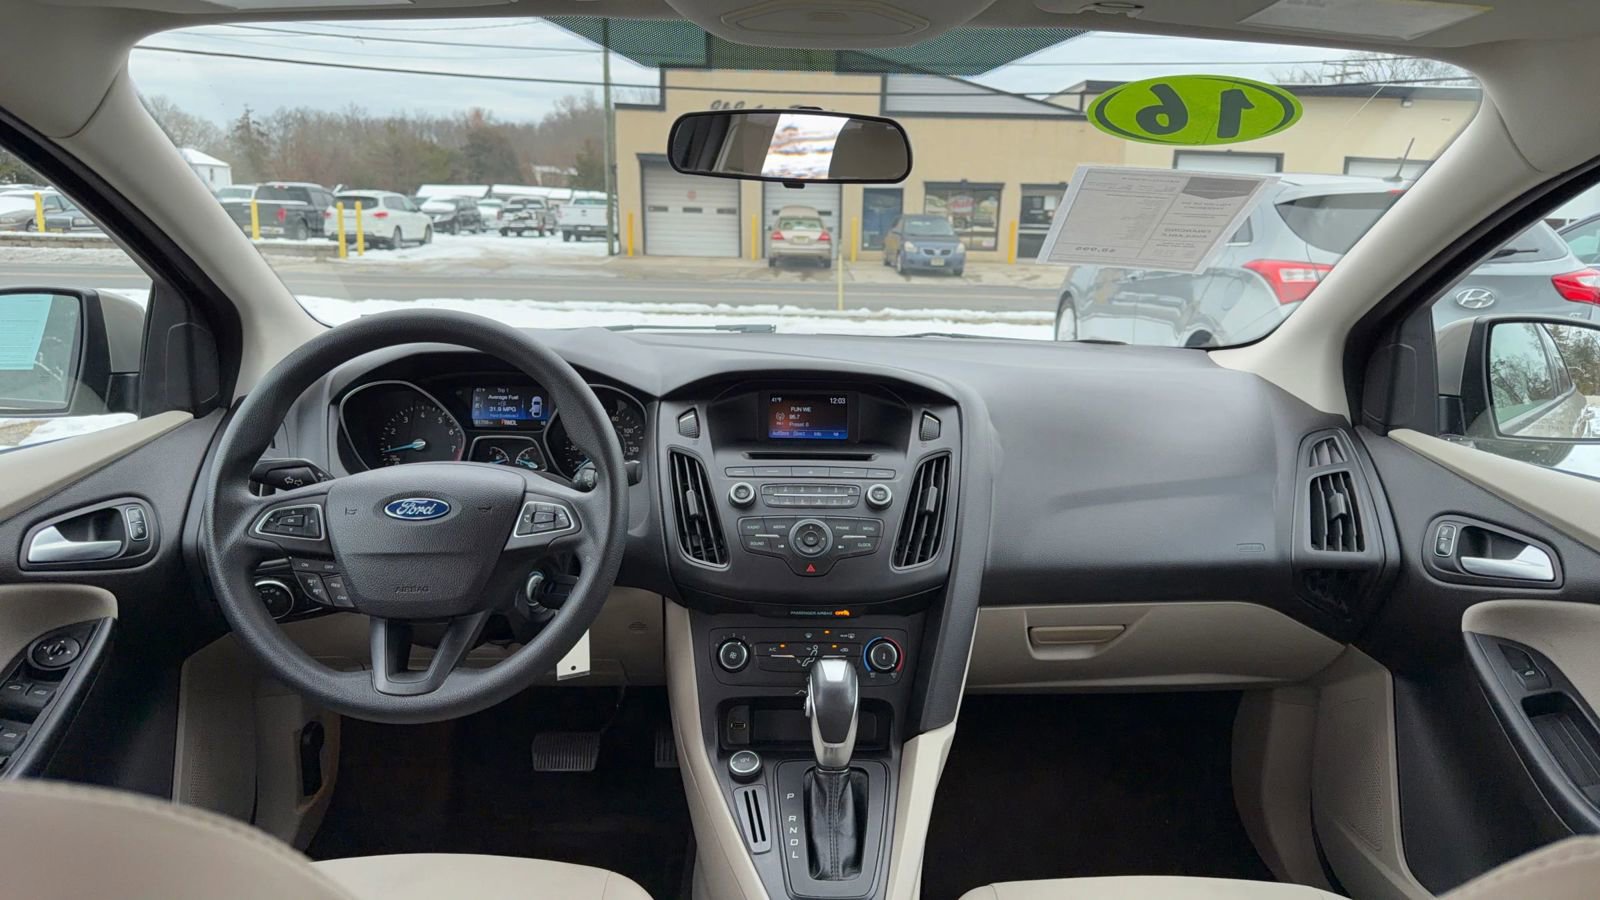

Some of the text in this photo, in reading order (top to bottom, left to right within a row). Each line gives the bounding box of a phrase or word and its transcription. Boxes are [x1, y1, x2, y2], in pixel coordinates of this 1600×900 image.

[395, 585, 430, 593] AIRBAG
[790, 838, 799, 846] D
[792, 851, 799, 859] L
